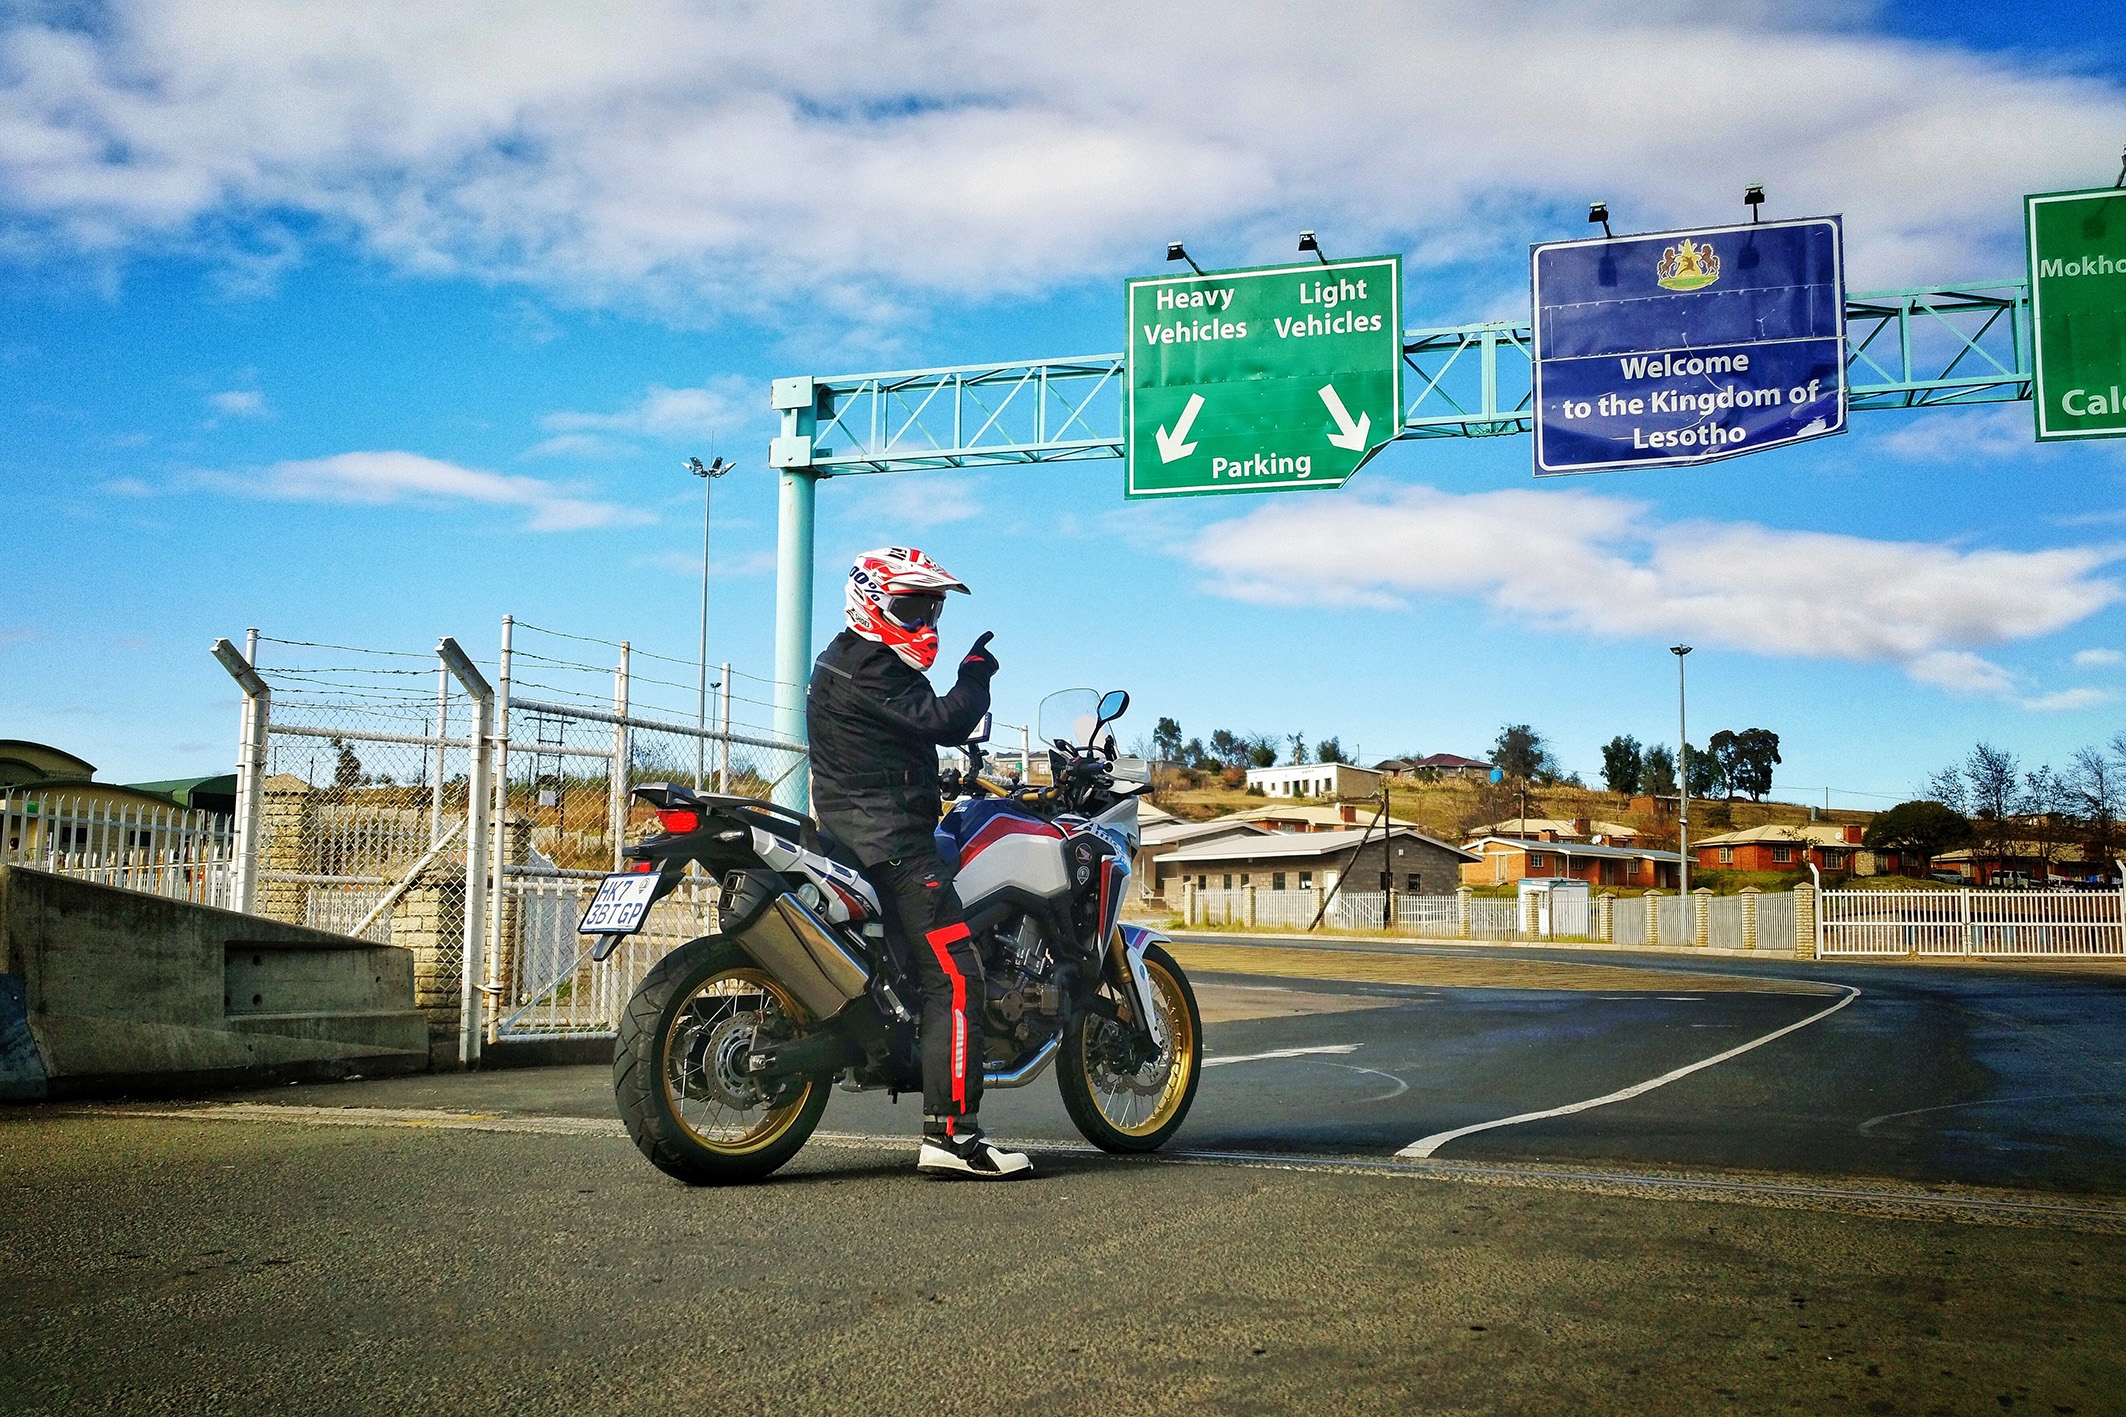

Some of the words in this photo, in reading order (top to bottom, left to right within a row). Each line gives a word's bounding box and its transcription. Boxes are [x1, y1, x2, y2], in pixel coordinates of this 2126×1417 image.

[1156, 287, 1235, 311] Heavy
[1300, 278, 1368, 308] Light
[1144, 318, 1248, 345] Vehicles
[1274, 311, 1382, 339] Vehicles
[1620, 354, 1749, 380] Welcome
[1562, 400, 1592, 419] to
[1598, 392, 1644, 416] the
[1651, 385, 1780, 416] Kingdom
[1788, 379, 1820, 403] of
[2061, 386, 2126, 416] Cal
[1633, 422, 1746, 450] Lesotho
[1212, 453, 1312, 479] Parking
